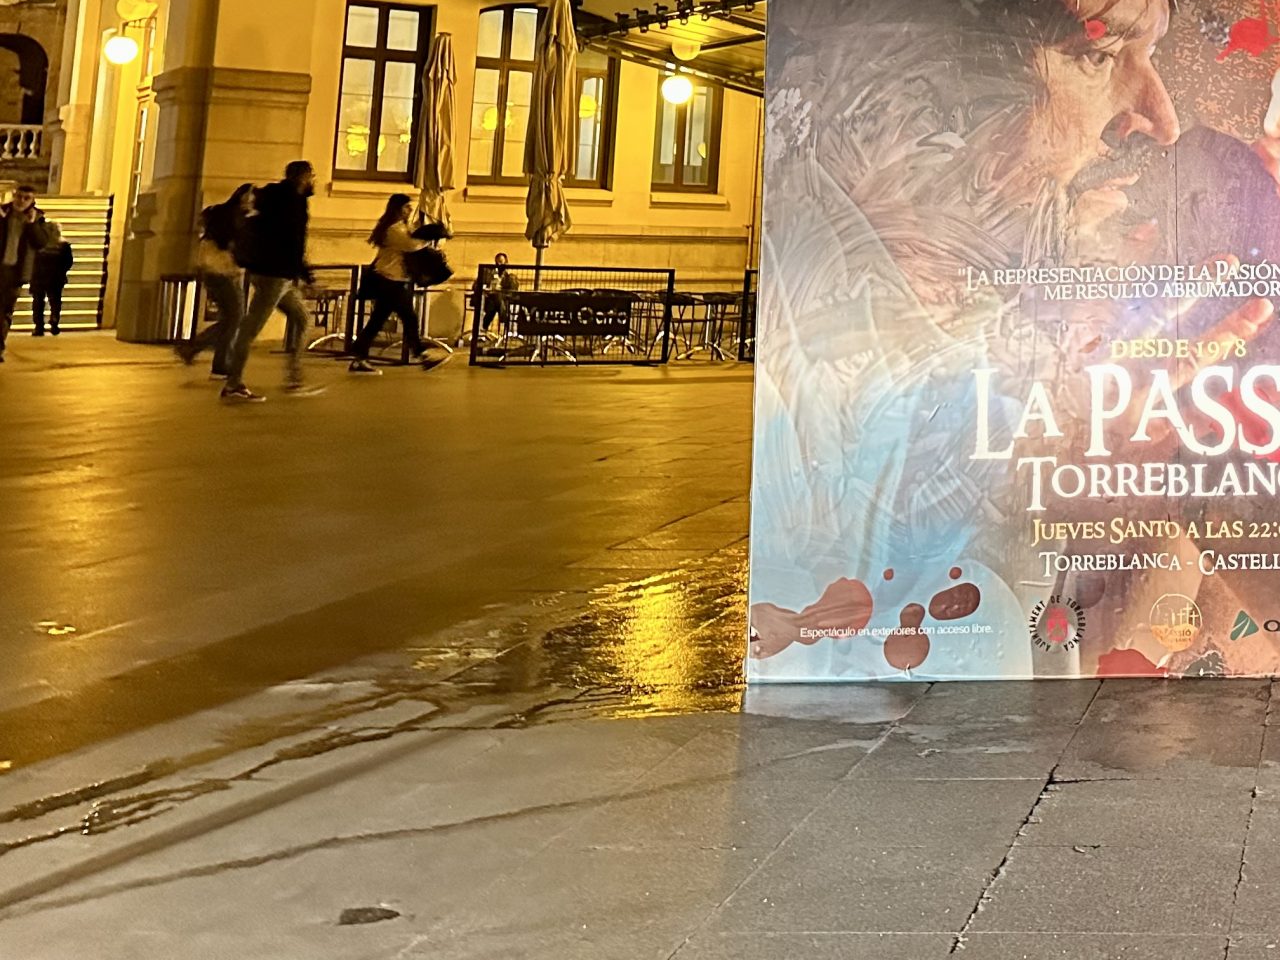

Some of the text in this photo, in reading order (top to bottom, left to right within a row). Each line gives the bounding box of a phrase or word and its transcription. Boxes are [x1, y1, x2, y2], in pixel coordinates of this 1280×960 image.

[993, 261, 1155, 286] REPRESENTACIÓN
[1158, 264, 1186, 282] DE
[1188, 264, 1212, 282] LA
[1043, 285, 1073, 301] ME
[1110, 338, 1247, 361] DESDE 1978
[968, 367, 1065, 460] LA
[1031, 518, 1105, 547] JUEVES
[1109, 517, 1181, 544] SANTO
[1185, 524, 1201, 539] A
[1205, 521, 1244, 539] LAS
[1039, 551, 1182, 577] TORREBLANCA
[800, 623, 994, 640] Espectáculo en exteriores con acceso libre.
[1029, 595, 1086, 652] AJUNTAMENT DE TORREBLANCA
